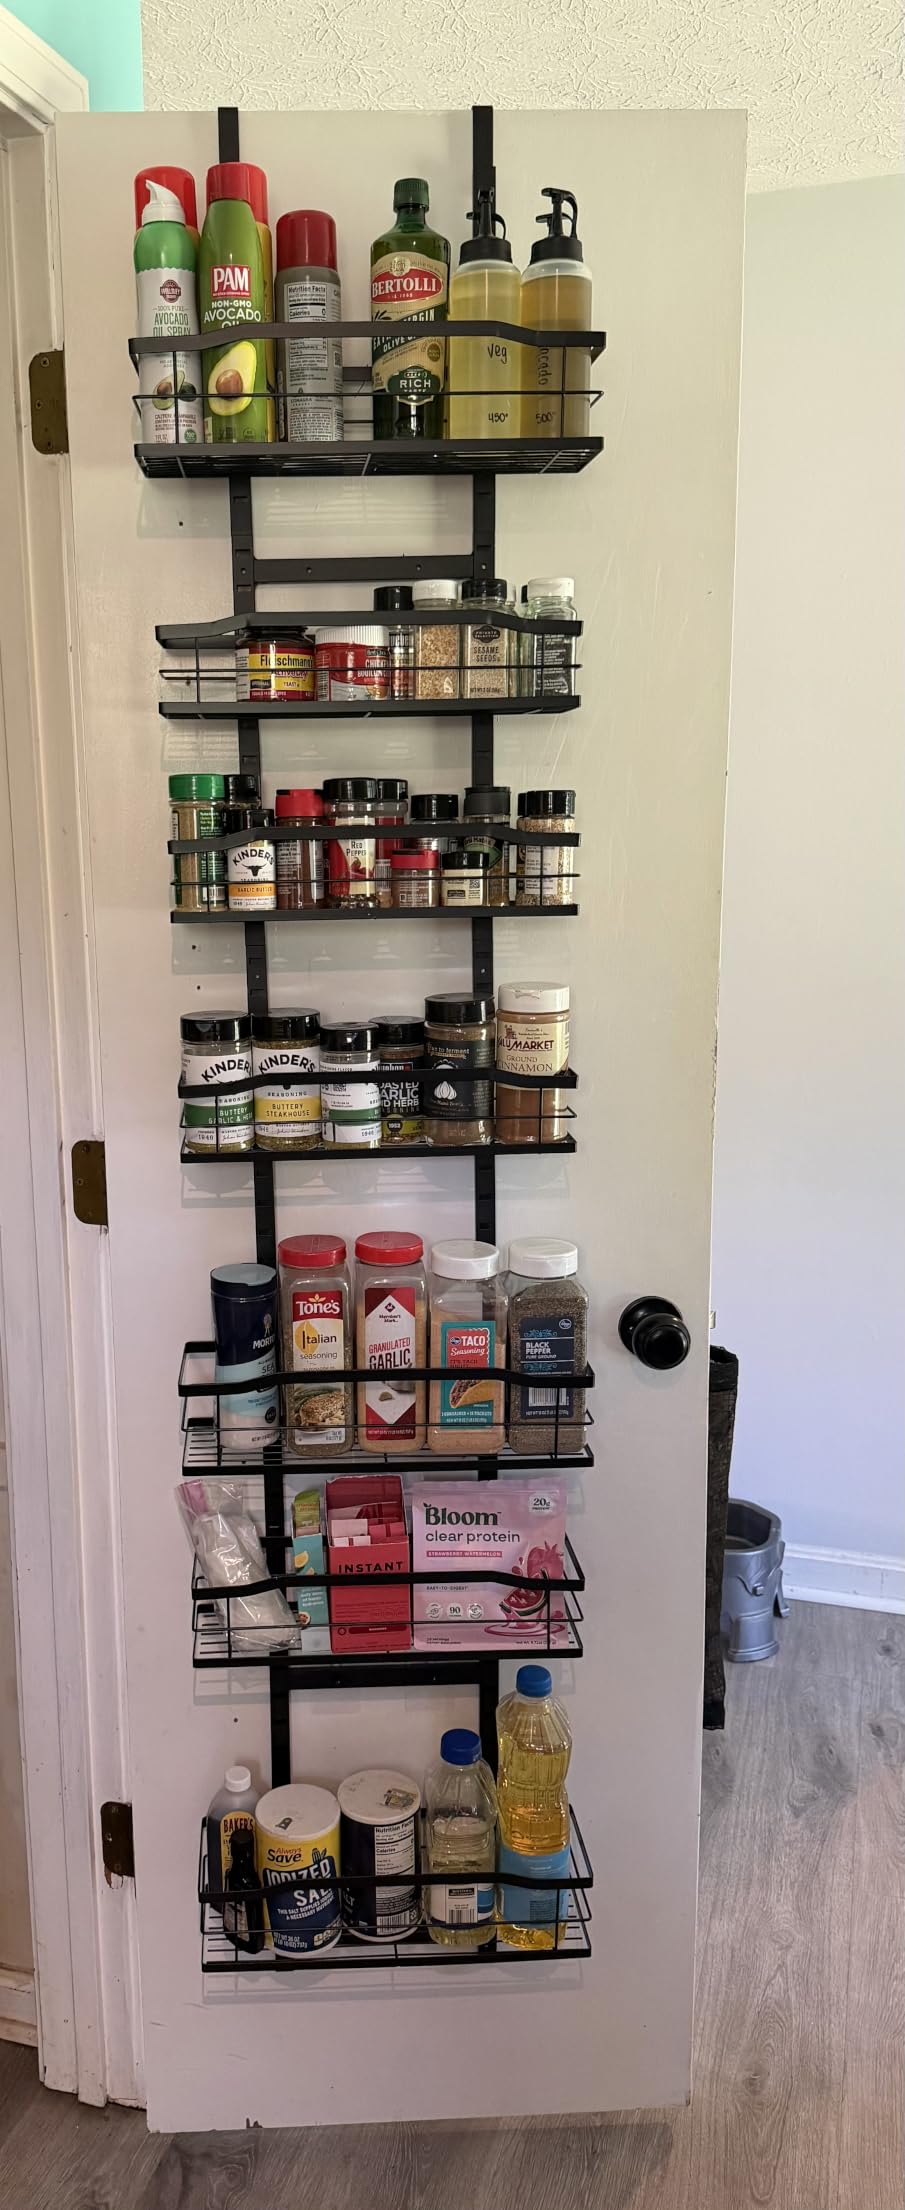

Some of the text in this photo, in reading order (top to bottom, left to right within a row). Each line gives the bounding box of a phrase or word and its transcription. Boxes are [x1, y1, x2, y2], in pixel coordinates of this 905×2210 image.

[213, 267, 249, 292] PAM
[289, 284, 311, 294] Nutrition
[372, 277, 437, 298] BERTOLLI
[212, 300, 252, 308] NON-GMO
[204, 309, 261, 323] AVOCADO
[289, 308, 310, 317] Calories
[155, 313, 189, 326] AVOCADO
[169, 327, 191, 336] SPRAY
[400, 379, 431, 389] RICH
[473, 646, 499, 654] SESAME
[351, 841, 363, 849] RED
[346, 849, 367, 857] PEPPER
[258, 1054, 316, 1075] KINDER'S
[506, 1055, 538, 1063] GROUND
[201, 1059, 252, 1082] KINDER
[218, 1096, 250, 1104] EASONING
[381, 1089, 419, 1100] ARLIC
[393, 1100, 419, 1108] HERB
[220, 1106, 248, 1117] BUTTERY
[266, 1110, 311, 1118] STEAKHOUSE
[296, 1299, 340, 1316] Tone's
[253, 1336, 275, 1350] MORT
[303, 1331, 338, 1350] Italian
[369, 1337, 411, 1354] GRANULATED
[462, 1336, 486, 1347] TACO
[300, 1352, 338, 1361] seasoning
[450, 1348, 486, 1357] Seasoning
[370, 1349, 411, 1370] GARLIC
[424, 1503, 499, 1526] Bloom
[426, 1530, 520, 1544] clear protein
[338, 1561, 403, 1573] INSTANT
[224, 1817, 254, 1833] BAKER'S
[376, 1824, 400, 1834] Nutrition
[267, 1849, 302, 1863] Save
[276, 1847, 302, 1856] Always
[293, 1888, 331, 1907] SAL
[288, 1907, 299, 1915] SALT
[290, 1909, 316, 1920] NECESSARY
